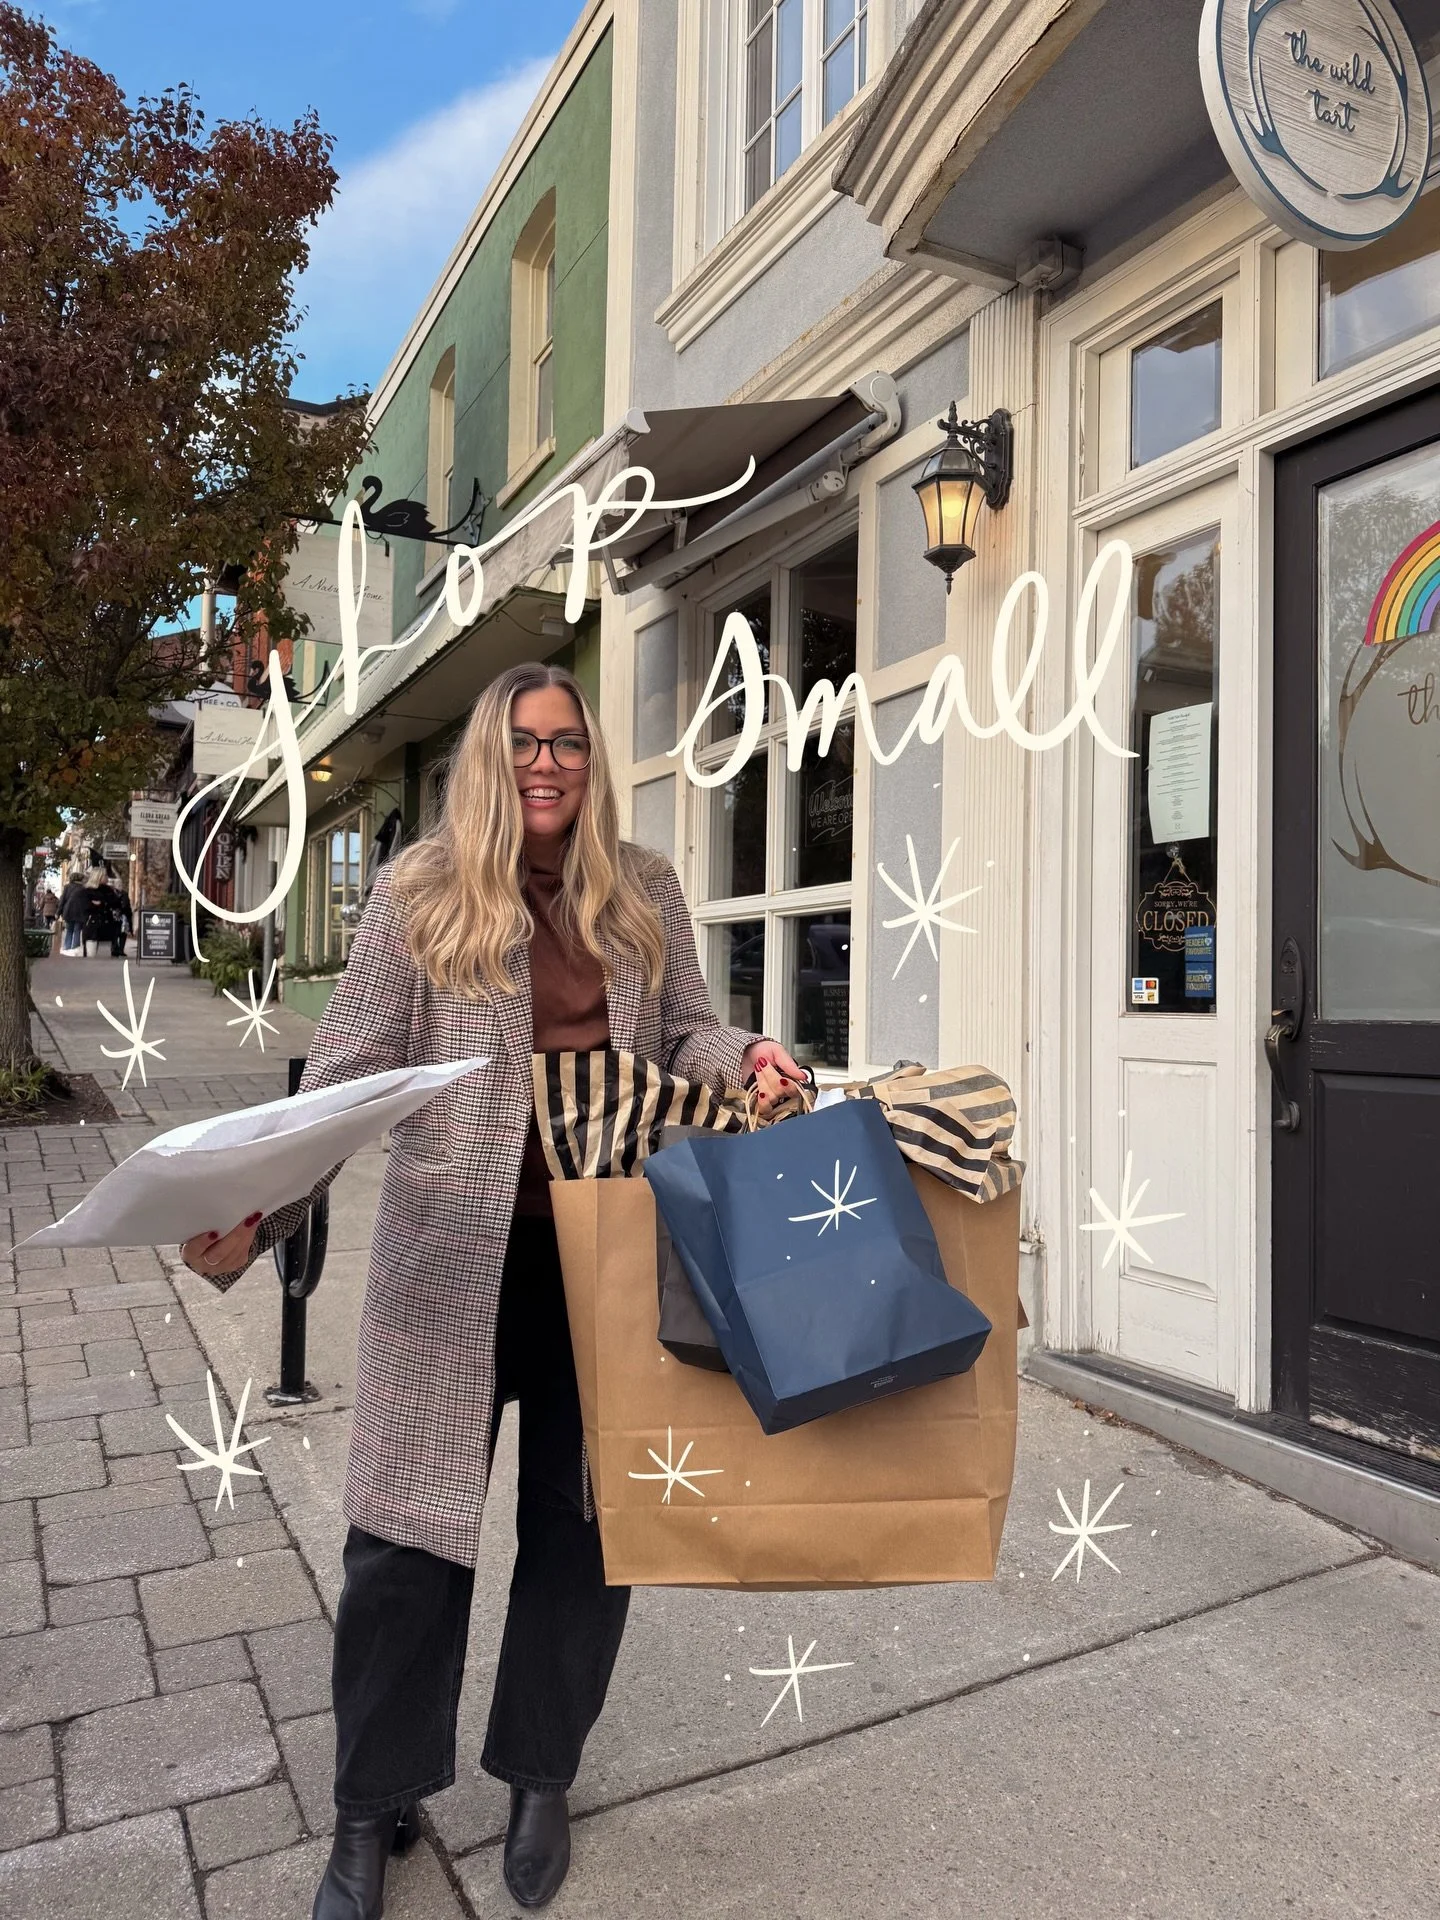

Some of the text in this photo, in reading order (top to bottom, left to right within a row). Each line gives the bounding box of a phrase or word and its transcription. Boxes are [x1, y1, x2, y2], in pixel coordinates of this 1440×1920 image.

[1284, 28, 1376, 95] the wild
[1307, 88, 1360, 133] tart
[293, 574, 312, 588] A
[309, 577, 340, 593] Natu
[1397, 672, 1440, 726] th
[808, 791, 854, 817] Welcom
[810, 809, 854, 829] WE ARE OPE
[215, 832, 233, 879] OPEN
[1177, 899, 1198, 908] WE'RE
[1143, 910, 1209, 932] CLOSED
[1185, 938, 1205, 947] READER
[1185, 946, 1212, 955] FAVOURITE
[1185, 974, 1204, 983] READER
[1185, 982, 1212, 991] FAVOURITE
